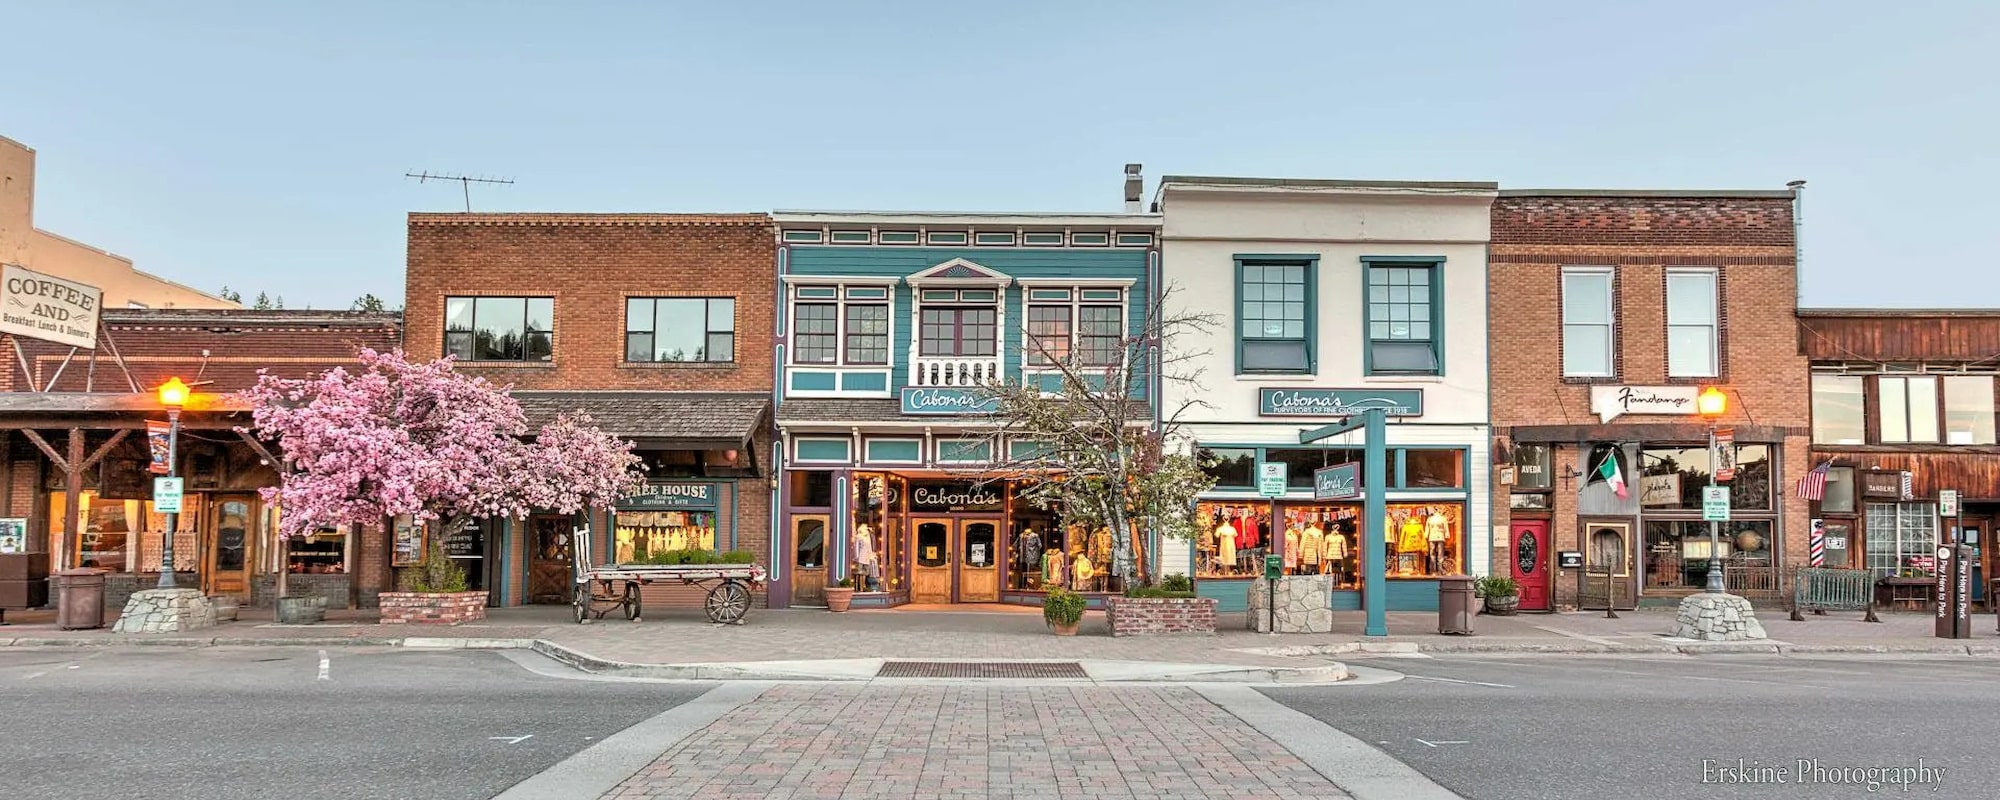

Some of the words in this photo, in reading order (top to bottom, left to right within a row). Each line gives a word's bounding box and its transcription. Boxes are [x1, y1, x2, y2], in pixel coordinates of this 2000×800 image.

[7, 278, 95, 312] COFFEE
[31, 302, 70, 321] AND
[3, 312, 36, 327] Breakfast
[38, 321, 58, 332] Lunch
[59, 323, 65, 333] &
[910, 389, 975, 409] Cabona's
[1271, 390, 1342, 408] Cabona's
[1618, 387, 1690, 412] Fandango
[1273, 406, 1311, 414] PURVEYORS
[1312, 406, 1323, 414] OF
[1323, 406, 1336, 414] FINE
[1521, 465, 1542, 474] AVEDA
[662, 485, 707, 499] HOUSE
[914, 487, 1001, 505] Cabona's
[1939, 561, 1948, 575] Pay
[1960, 561, 1968, 575] Pay
[1939, 575, 1947, 593] Here
[1939, 593, 1946, 601] to
[1960, 593, 1966, 602] to
[1938, 602, 1946, 618] Park
